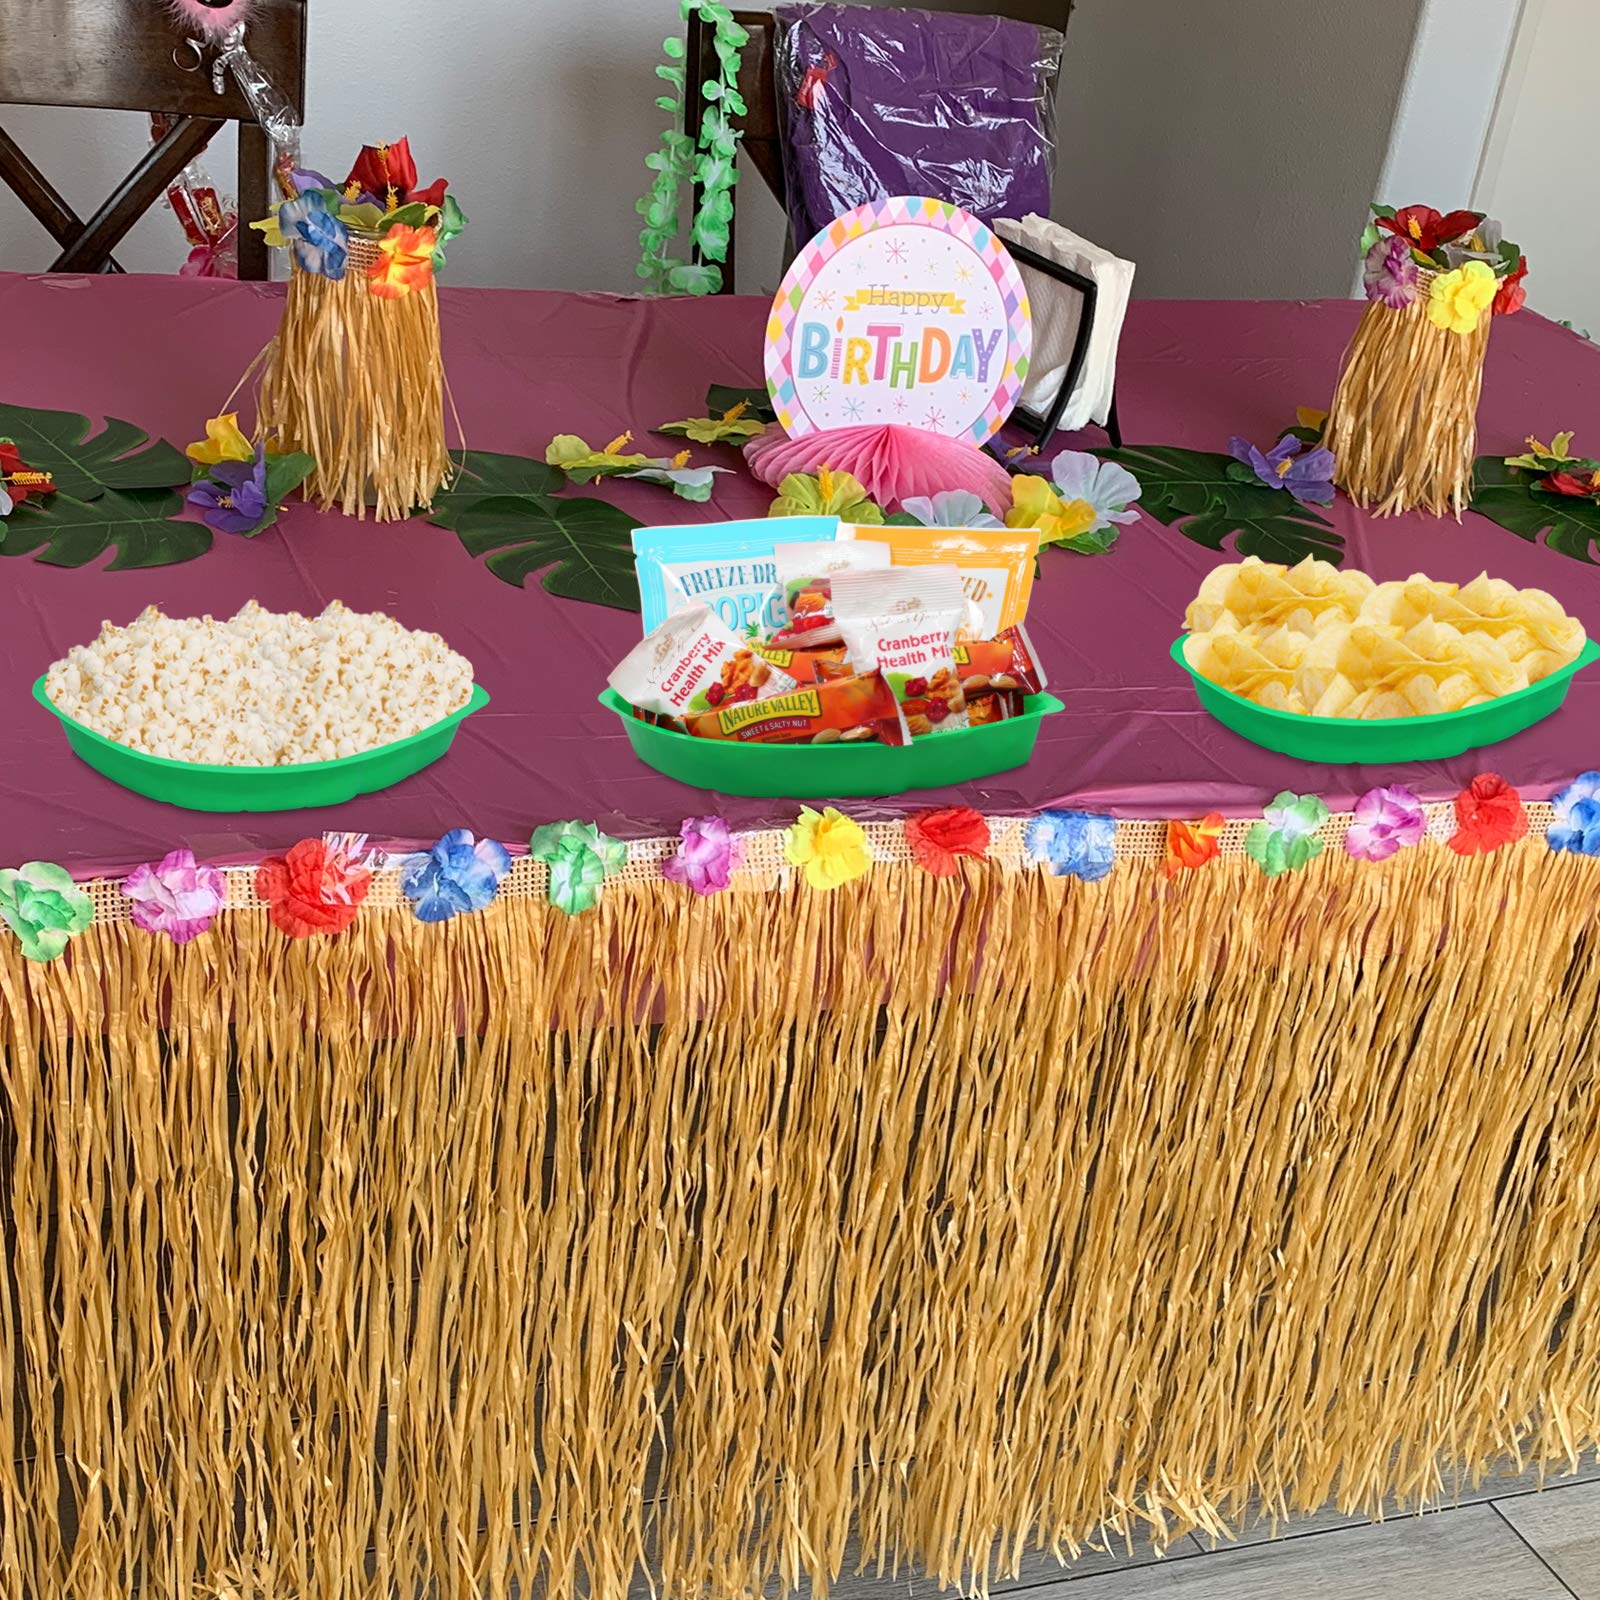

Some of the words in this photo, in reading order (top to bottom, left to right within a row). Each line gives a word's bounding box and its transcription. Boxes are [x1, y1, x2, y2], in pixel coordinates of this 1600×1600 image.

[867, 284, 948, 315] Happy
[876, 651, 927, 669] Health
[931, 644, 954, 660] Mi
[877, 631, 950, 652] Cranberry
[661, 632, 711, 693] Cranberry
[669, 663, 707, 707] Health
[702, 640, 726, 664] Mix
[721, 701, 770, 731] NATURE
[769, 691, 815, 713] VALLEY
[741, 725, 763, 739] SWEET
[769, 720, 791, 730] SALTY
[792, 719, 807, 728] NUT
